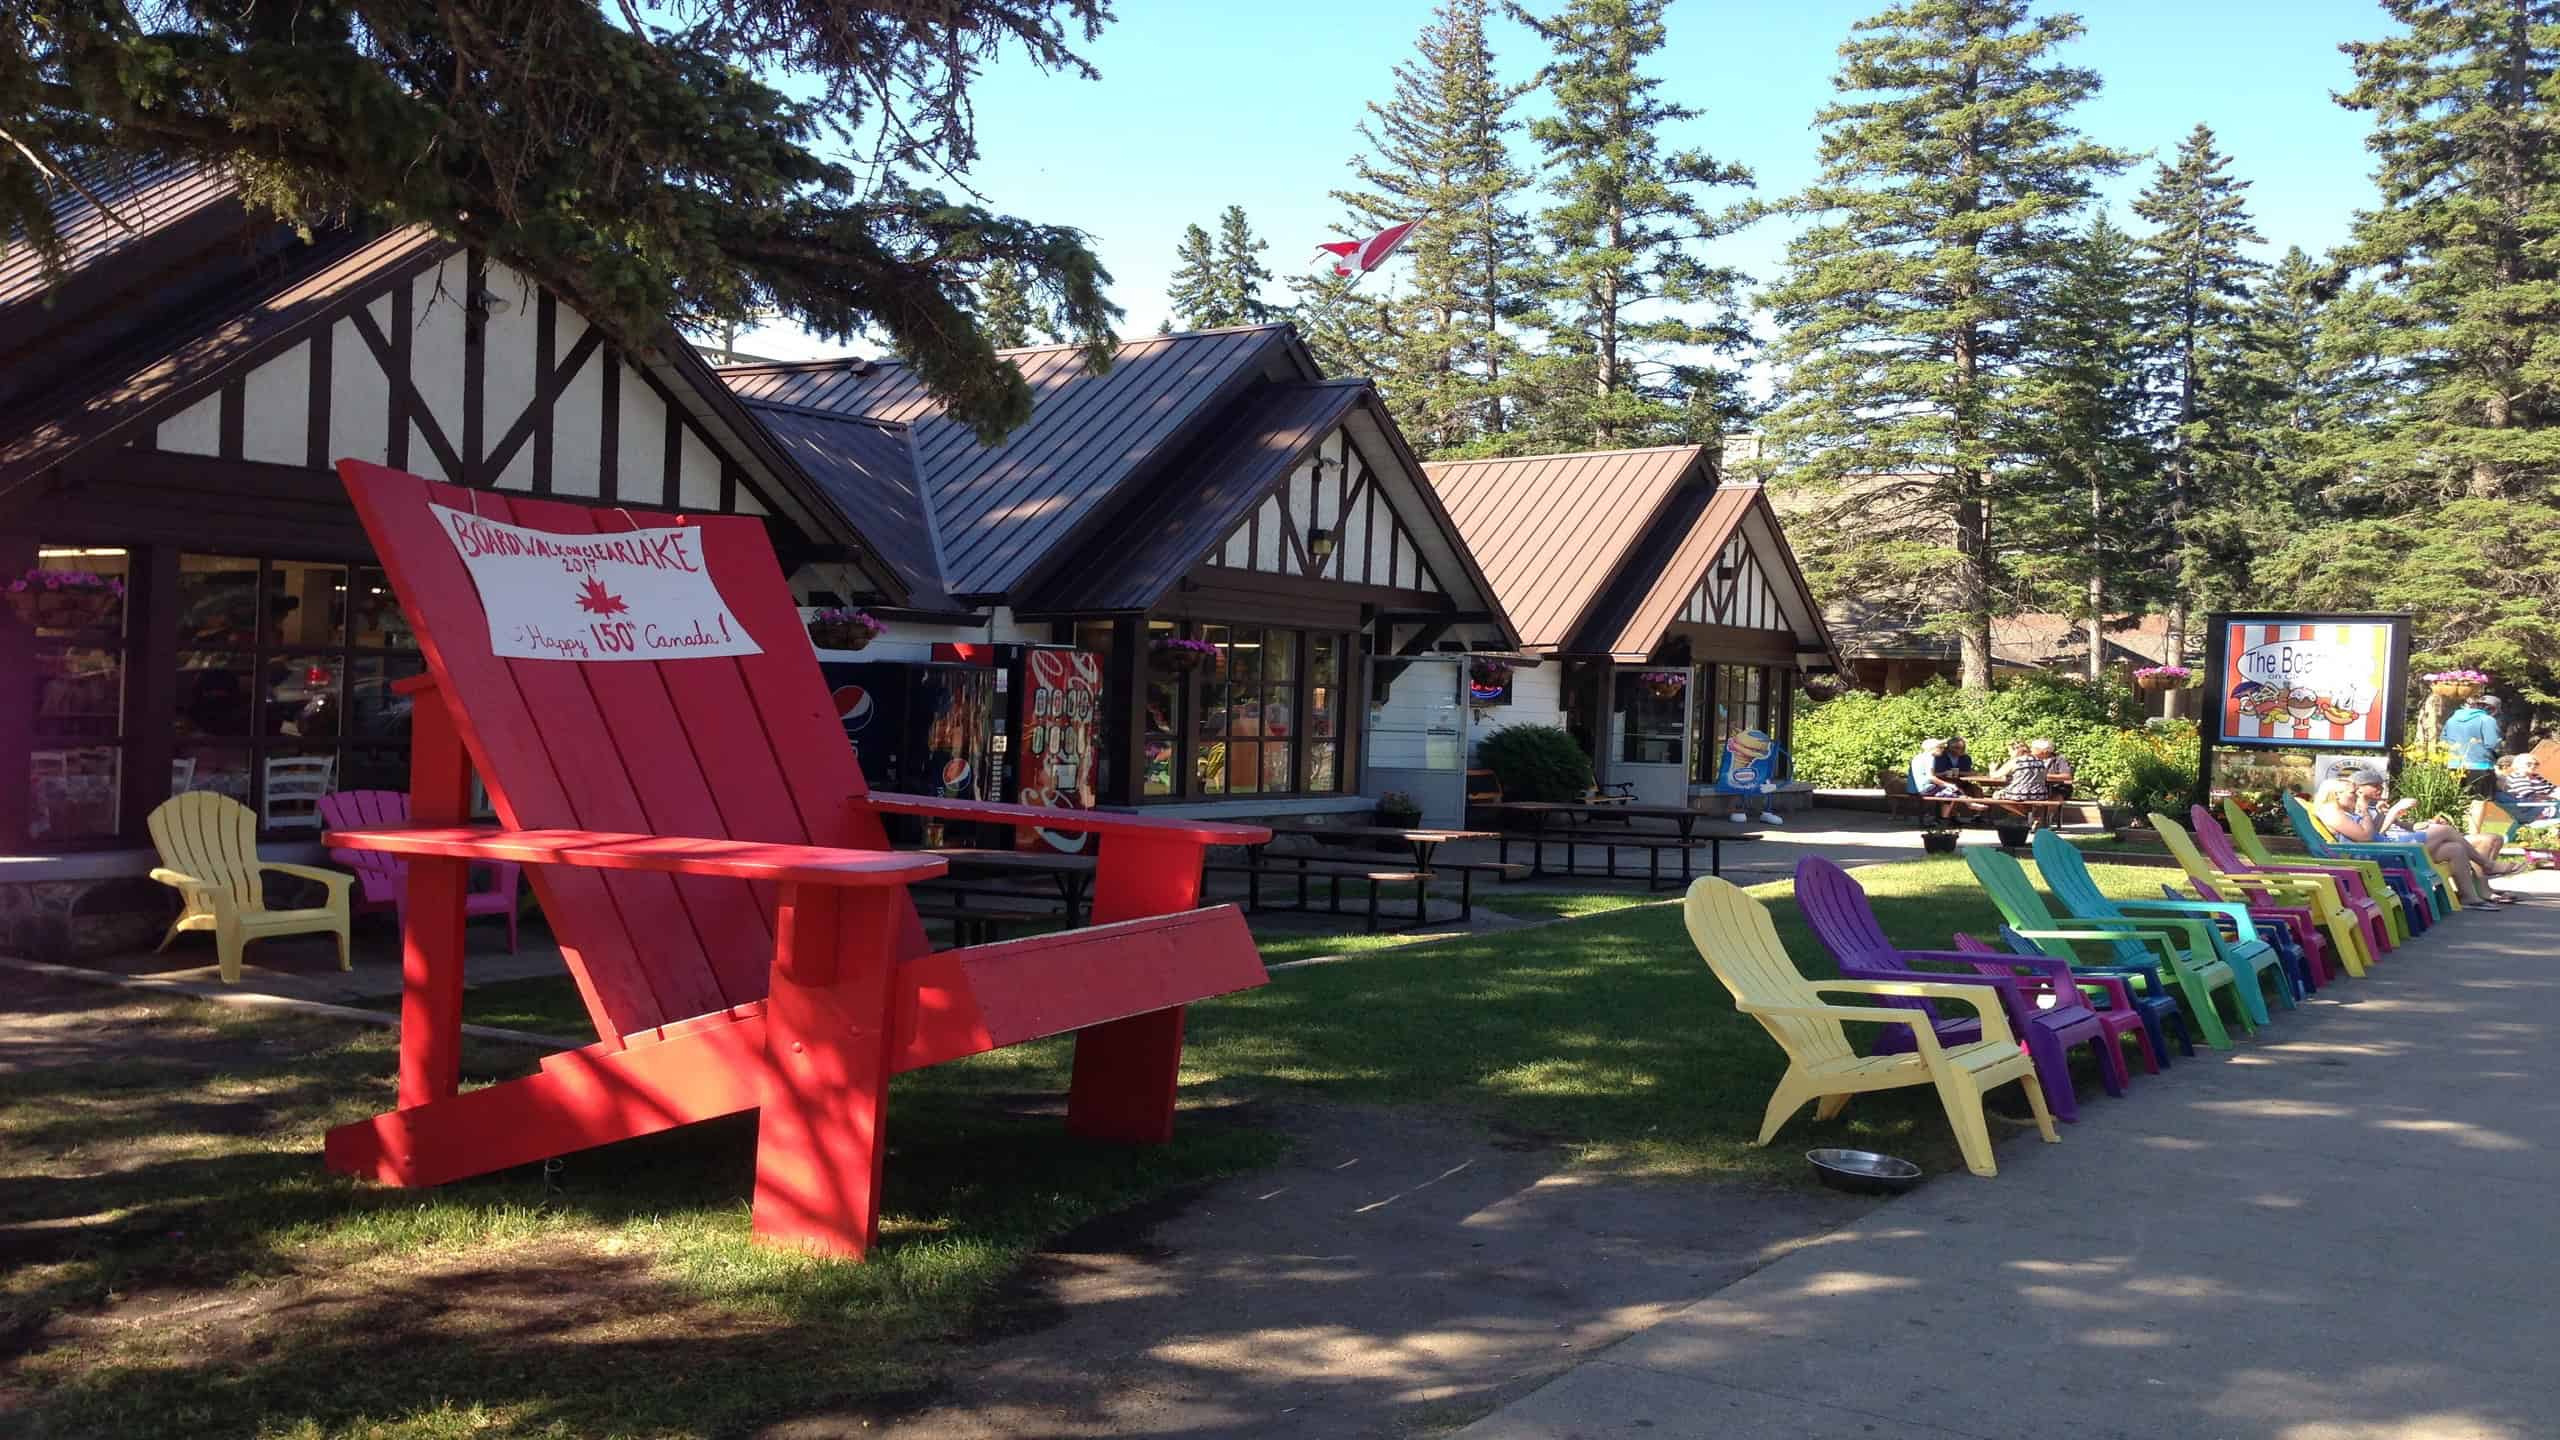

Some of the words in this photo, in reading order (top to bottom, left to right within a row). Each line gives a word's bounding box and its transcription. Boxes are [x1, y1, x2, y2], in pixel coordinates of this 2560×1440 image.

[451, 513, 567, 557] BOARDWALK
[626, 532, 698, 572] LAKE
[562, 558, 596, 573] 2017
[526, 624, 588, 657] Happy
[2246, 651, 2276, 673] The
